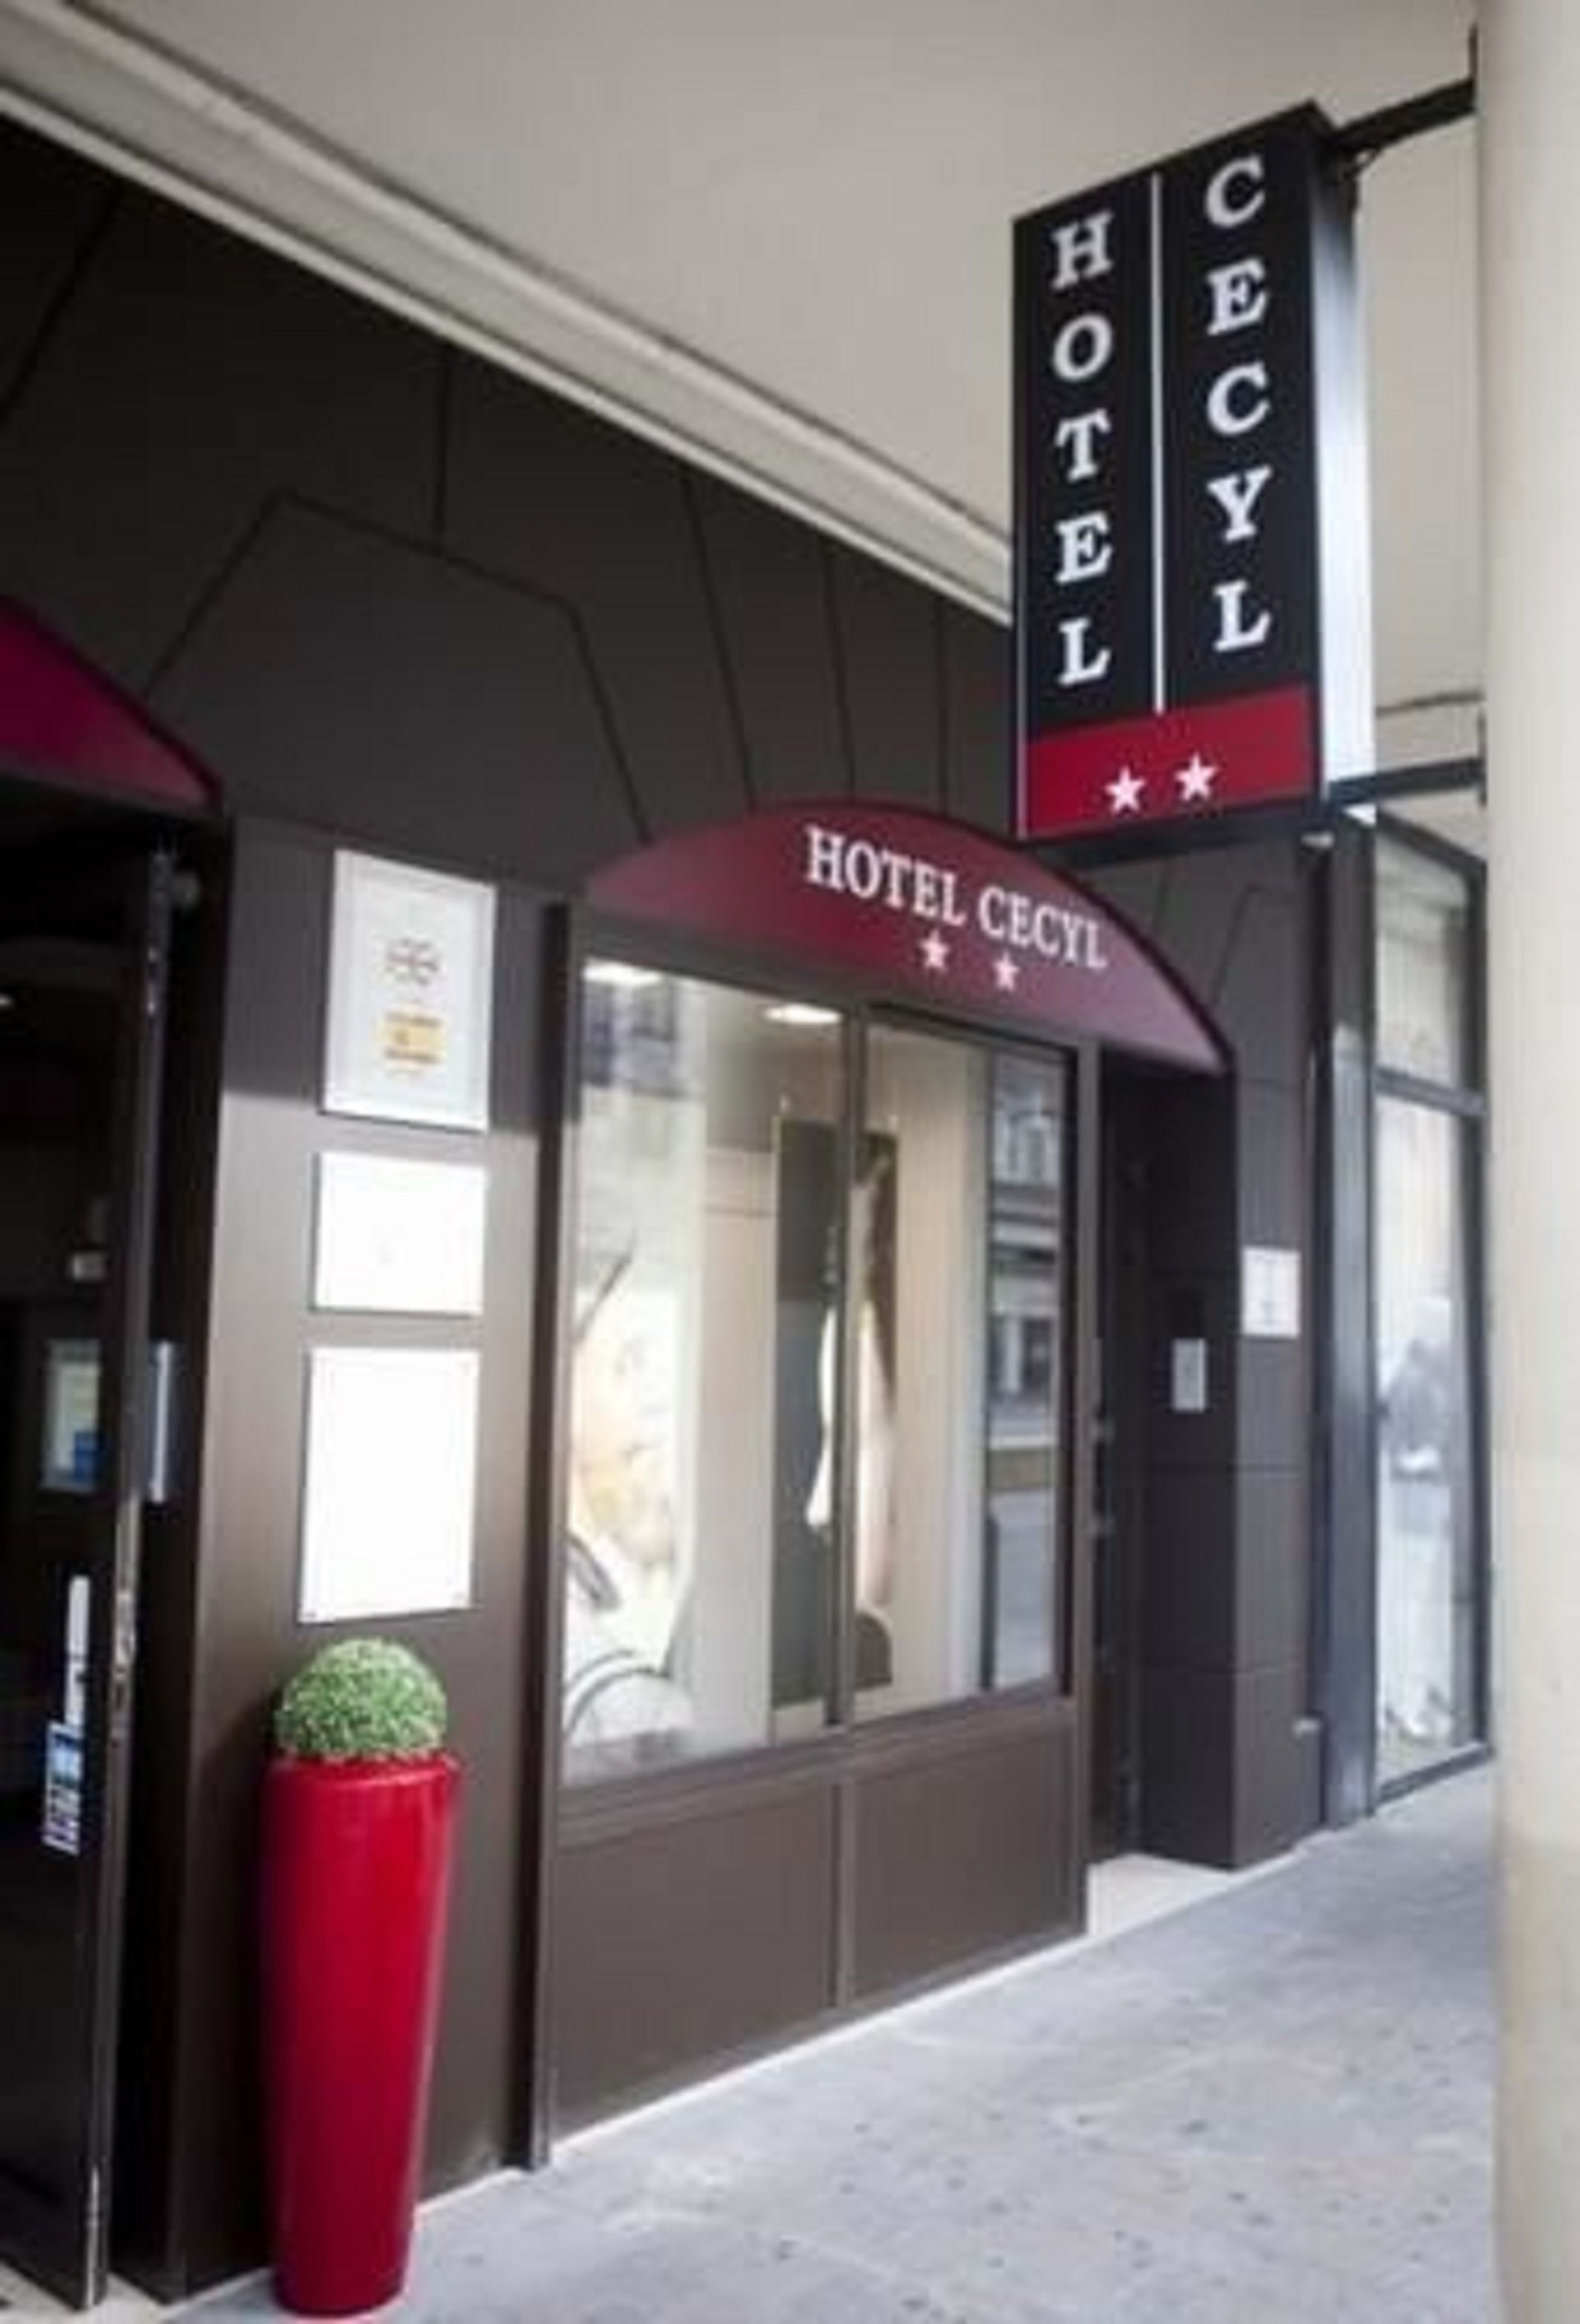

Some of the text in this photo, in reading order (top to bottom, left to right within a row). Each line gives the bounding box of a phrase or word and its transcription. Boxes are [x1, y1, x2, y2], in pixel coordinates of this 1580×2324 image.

[1051, 211, 1113, 687] HOTEL
[1205, 155, 1271, 654] CECYL
[805, 824, 1107, 970] HOTEL CECYL
